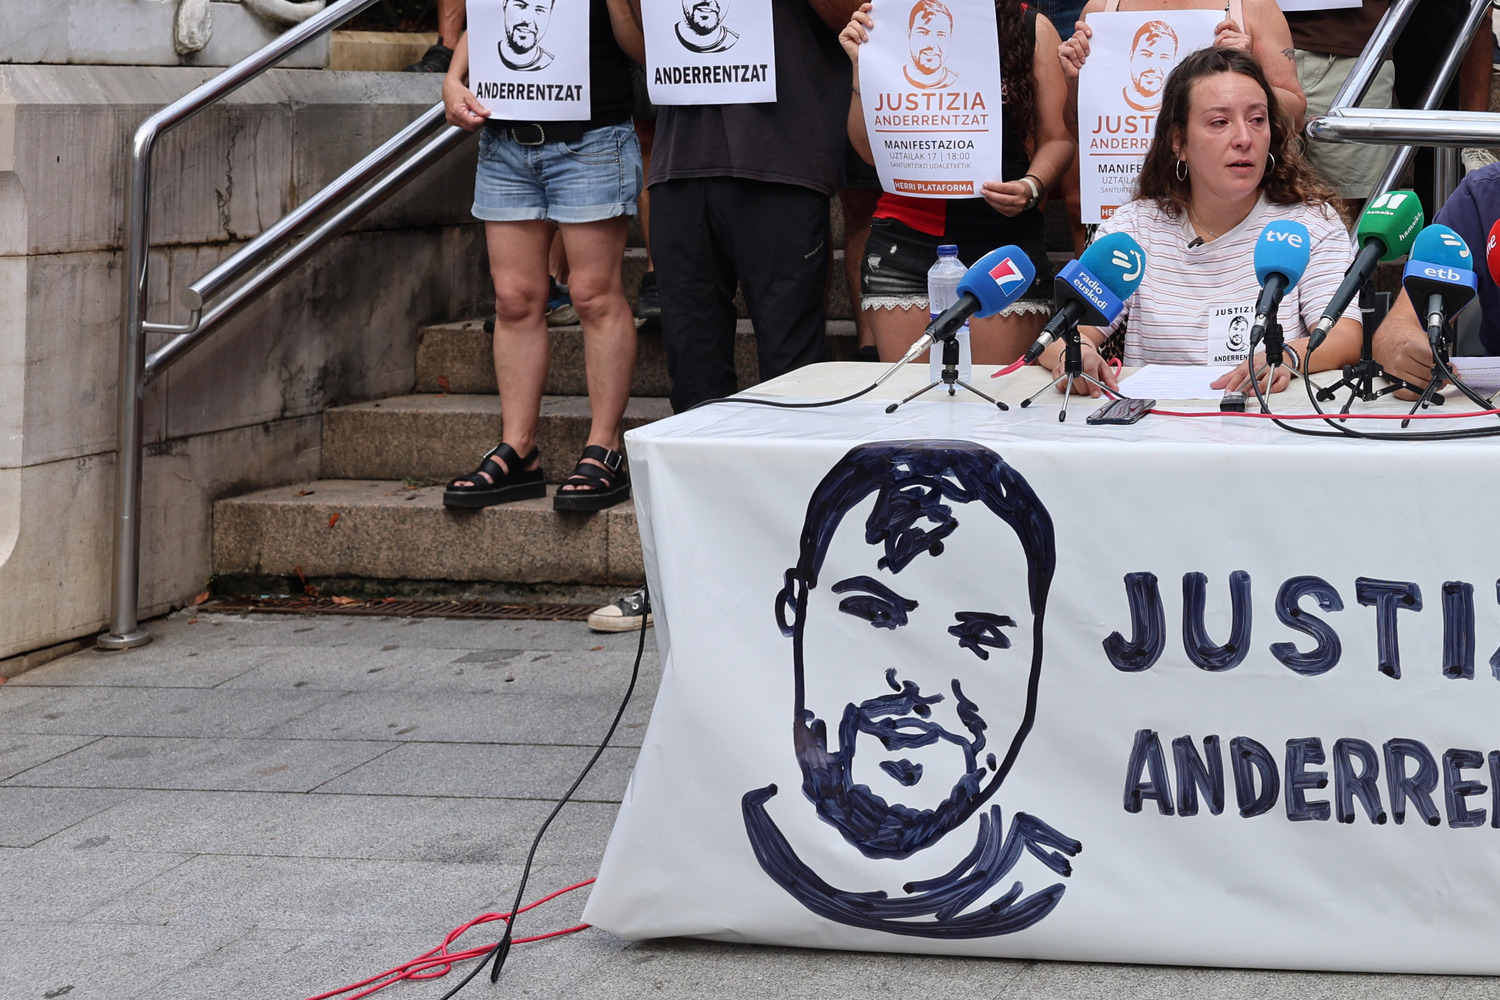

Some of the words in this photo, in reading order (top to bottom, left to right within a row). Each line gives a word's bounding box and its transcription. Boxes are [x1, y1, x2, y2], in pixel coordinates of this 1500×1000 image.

[654, 64, 768, 85] ANDERRENTZAT
[476, 82, 582, 102] ANDERRENTZAT
[874, 92, 986, 111] JUSTIZIA
[874, 114, 989, 126] ANDERRENTZAT
[1092, 115, 1155, 134] JUST
[884, 140, 975, 149] MANIFESTAZIOA
[890, 152, 925, 160] UZTAILAK
[928, 152, 937, 160] 17
[947, 152, 970, 160] 18:00
[890, 161, 928, 170] SANTURTZIKO
[895, 181, 915, 190] HERRI
[918, 183, 973, 192] PLATAFORMA
[1265, 230, 1303, 248] tve
[1424, 267, 1460, 281] etb
[1079, 272, 1103, 294] radio
[1073, 279, 1108, 310] euskadi
[1215, 306, 1254, 317] JUSTIZI
[1214, 354, 1249, 363] ANDERREN
